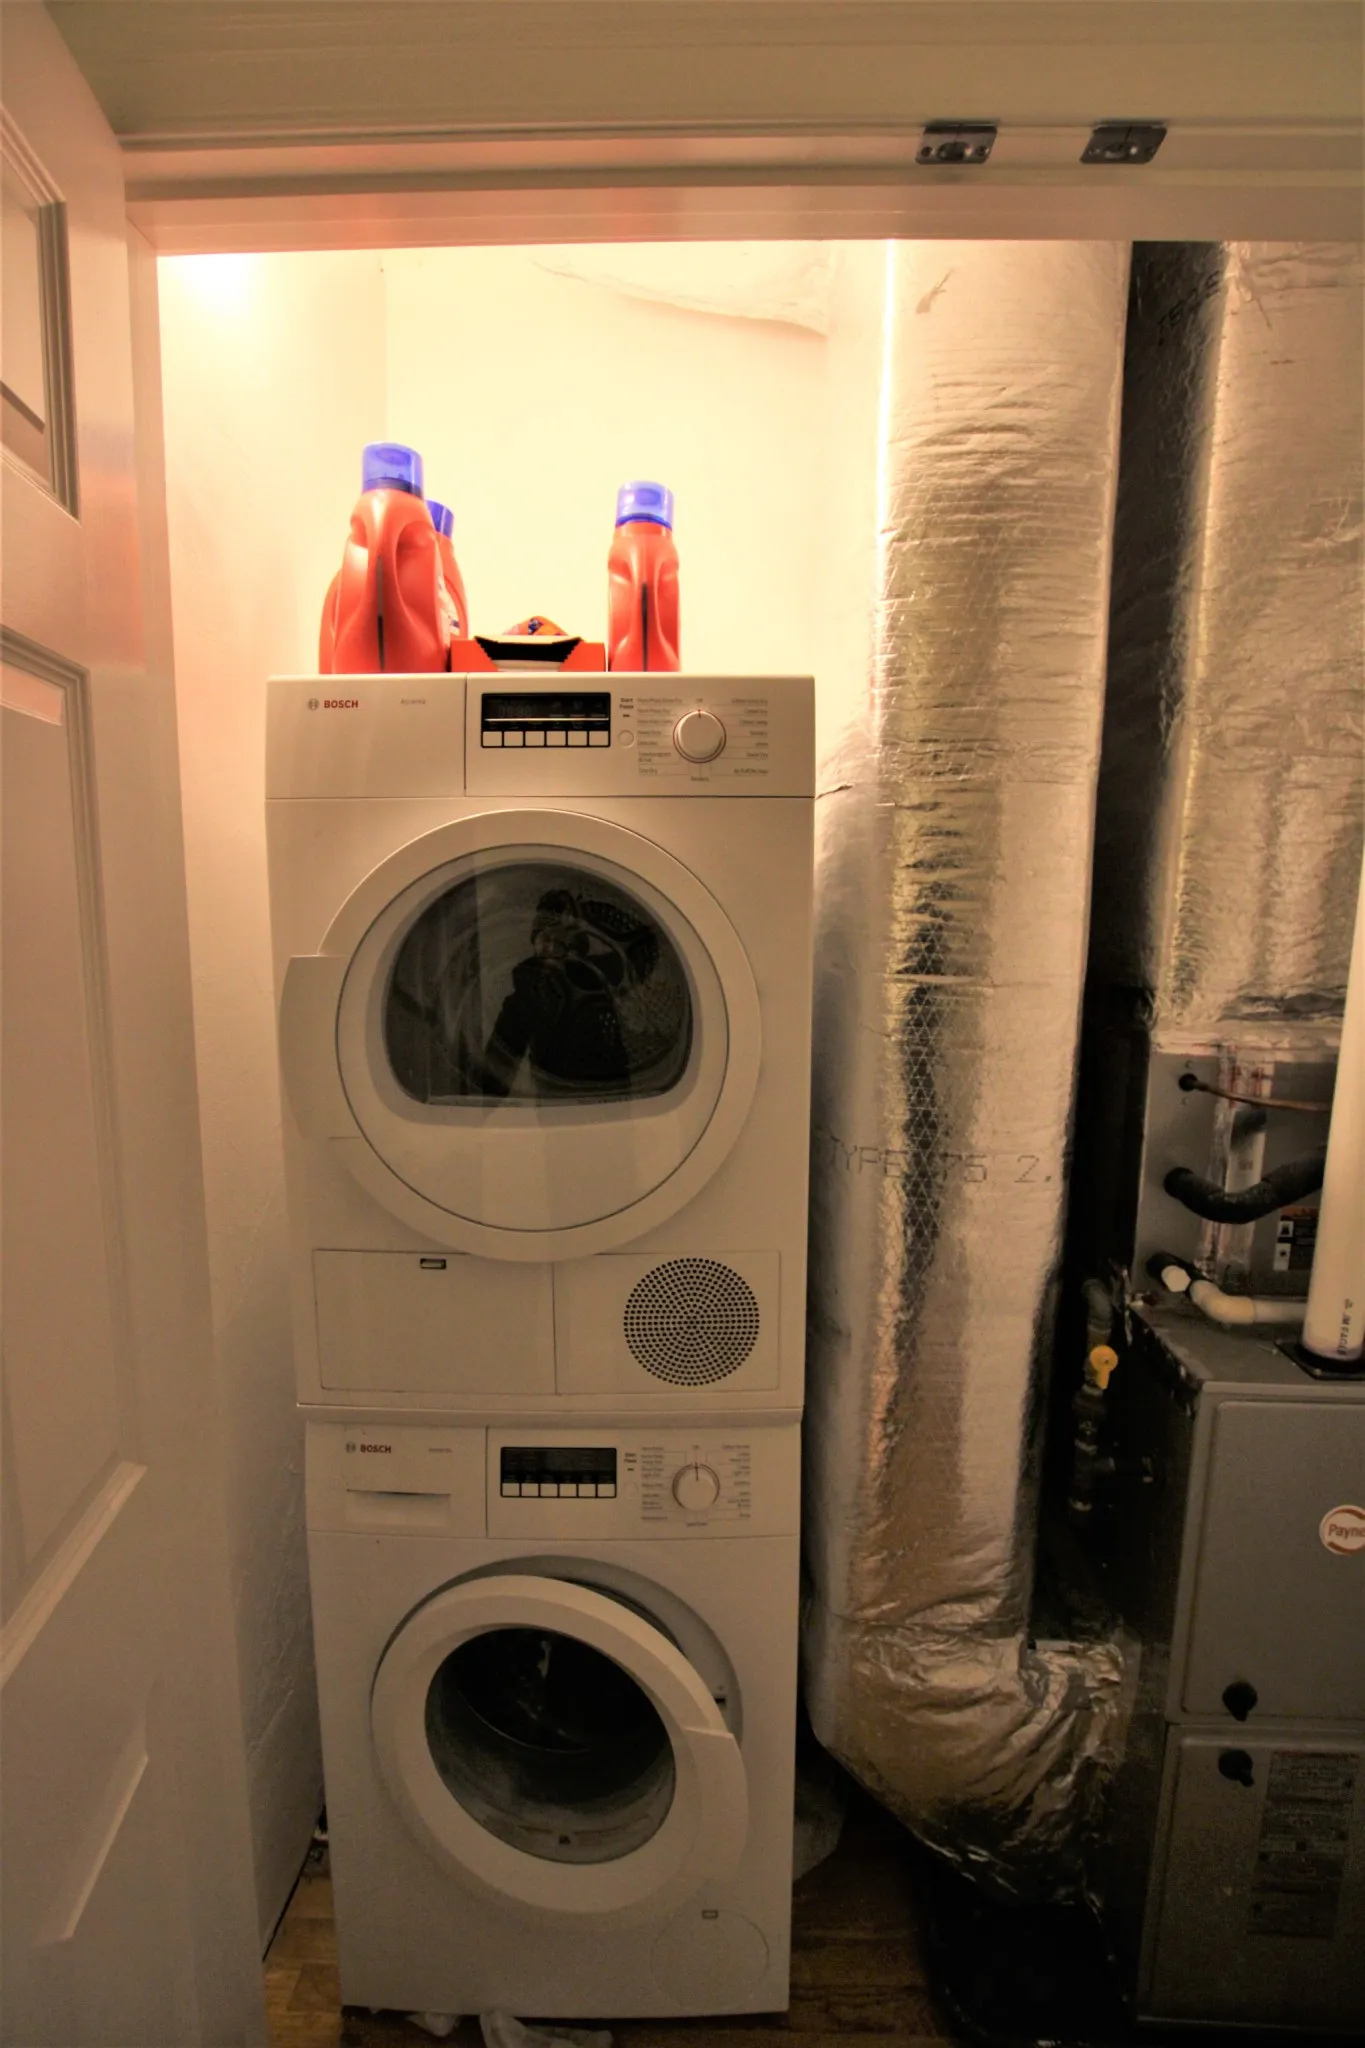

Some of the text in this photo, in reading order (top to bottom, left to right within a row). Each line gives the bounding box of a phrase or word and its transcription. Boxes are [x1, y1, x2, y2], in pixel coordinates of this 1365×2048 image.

[324, 700, 358, 709] BOSCH
[830, 1136, 908, 1178] TYPE
[360, 1444, 392, 1454] BOSCH
